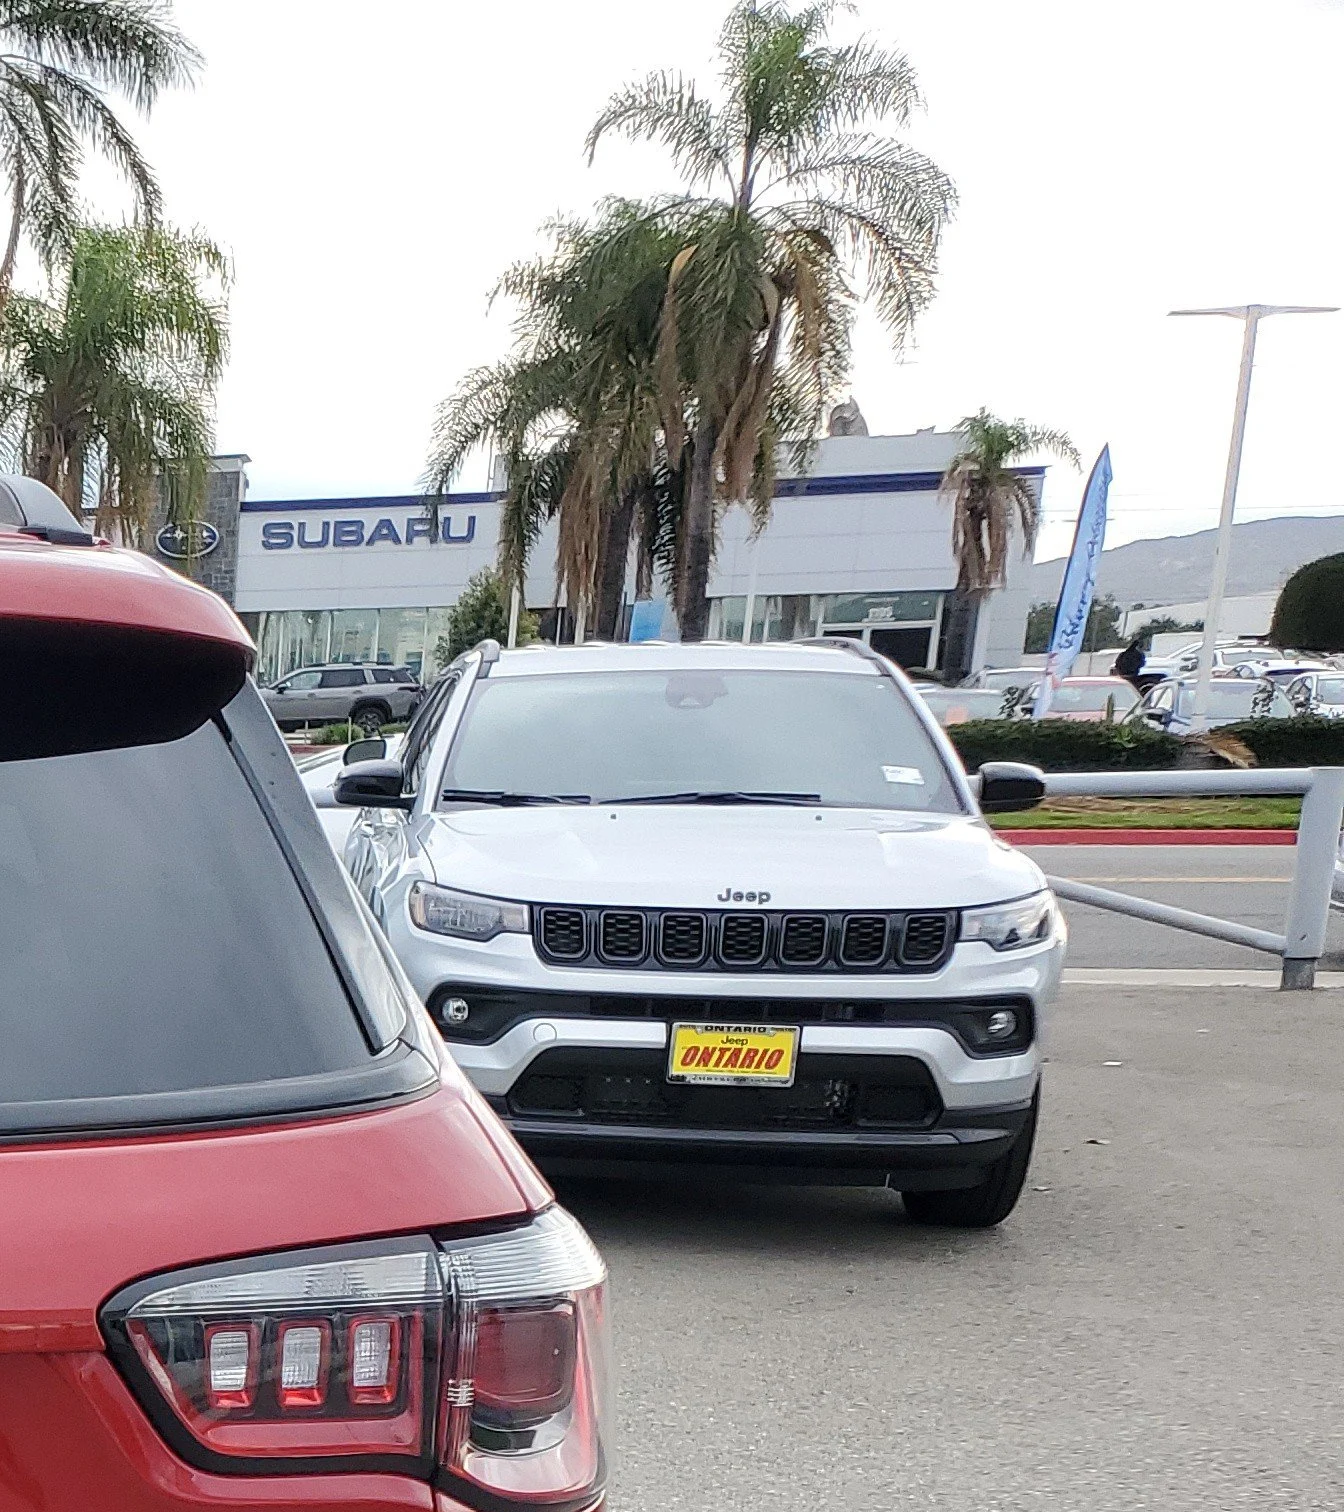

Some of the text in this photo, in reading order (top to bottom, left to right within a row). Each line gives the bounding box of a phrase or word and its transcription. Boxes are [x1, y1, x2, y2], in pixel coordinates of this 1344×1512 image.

[262, 515, 477, 550] SUBARU
[717, 887, 771, 905] Jeep
[704, 1024, 767, 1034] ONTARIO
[720, 1035, 749, 1047] Jeep
[680, 1045, 785, 1070] ONTARIO
